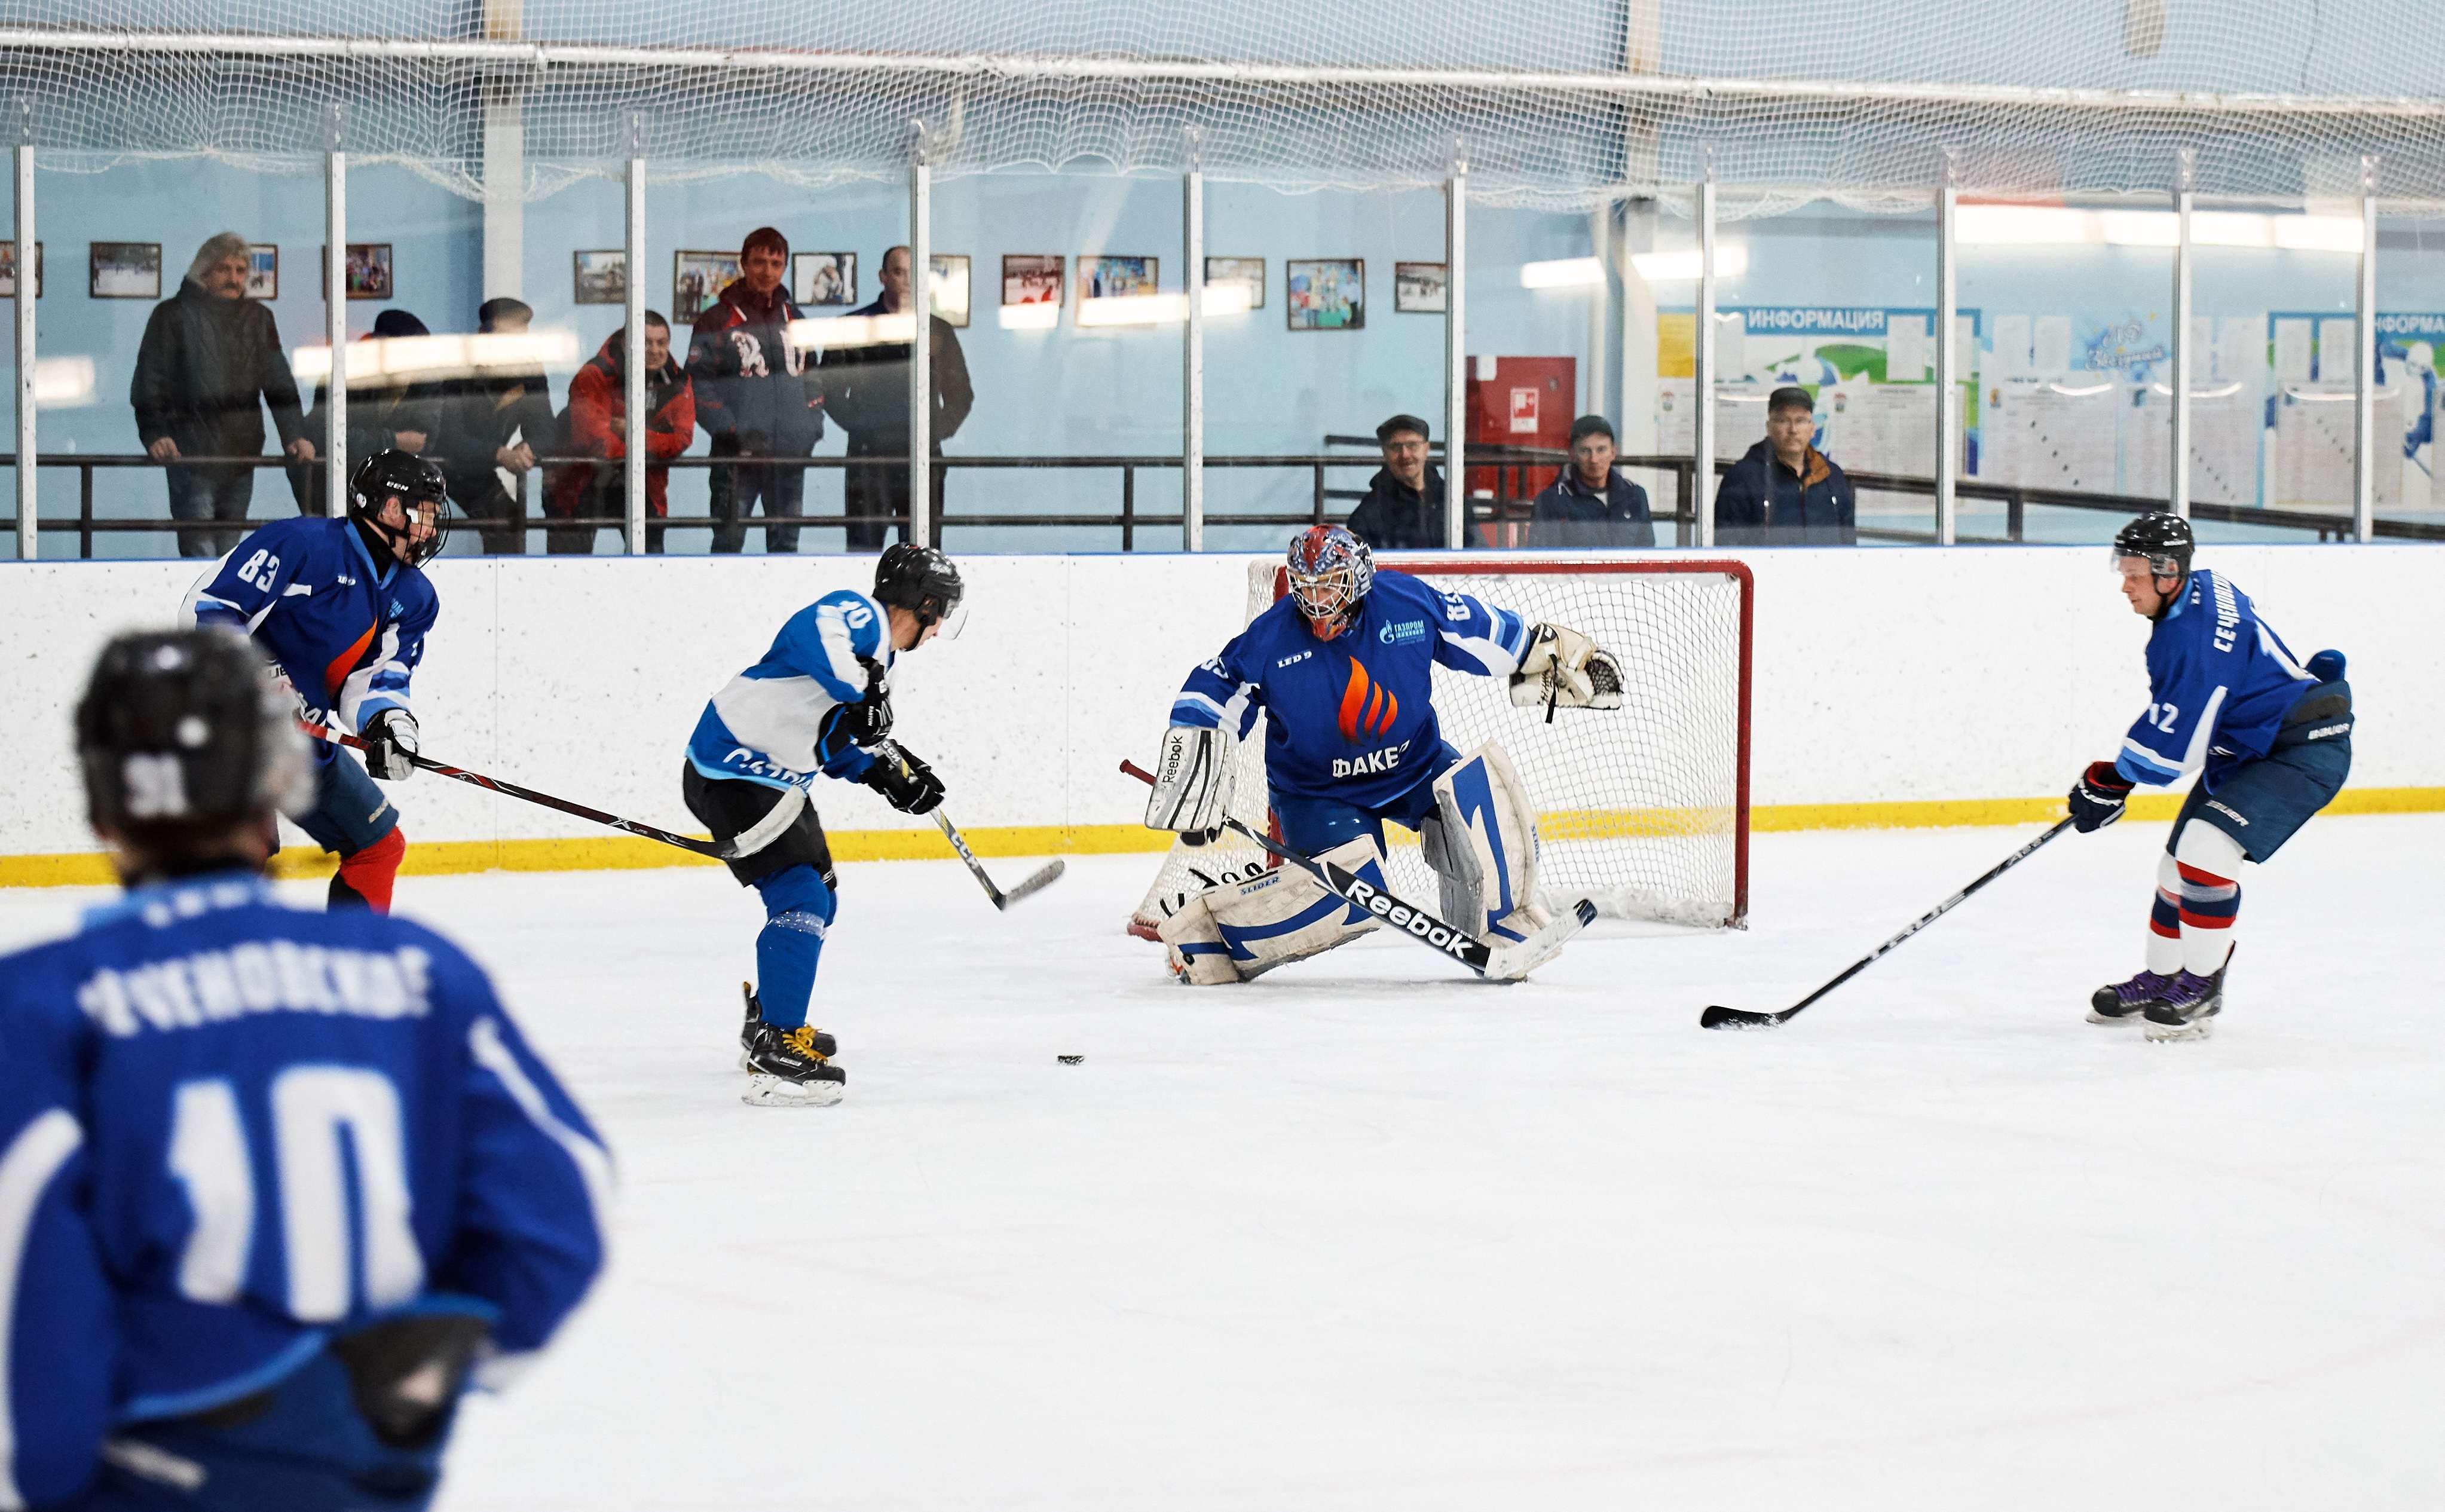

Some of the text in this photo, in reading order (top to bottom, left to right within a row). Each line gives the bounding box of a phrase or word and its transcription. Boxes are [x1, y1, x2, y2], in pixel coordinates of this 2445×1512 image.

[1748, 309, 1884, 332] ИНФОРМАЦИЯ
[237, 549, 280, 593] 83
[838, 600, 873, 629] 10
[1394, 619, 1424, 633] ГАЗПРОМ
[2149, 702, 2179, 734] 12
[882, 740, 901, 762] CCM
[1162, 736, 1183, 783] Reebok
[950, 831, 980, 870] CCM
[1240, 876, 1280, 895] SLIDER
[1345, 879, 1474, 959] Reebok
[168, 1064, 426, 1323] 10
